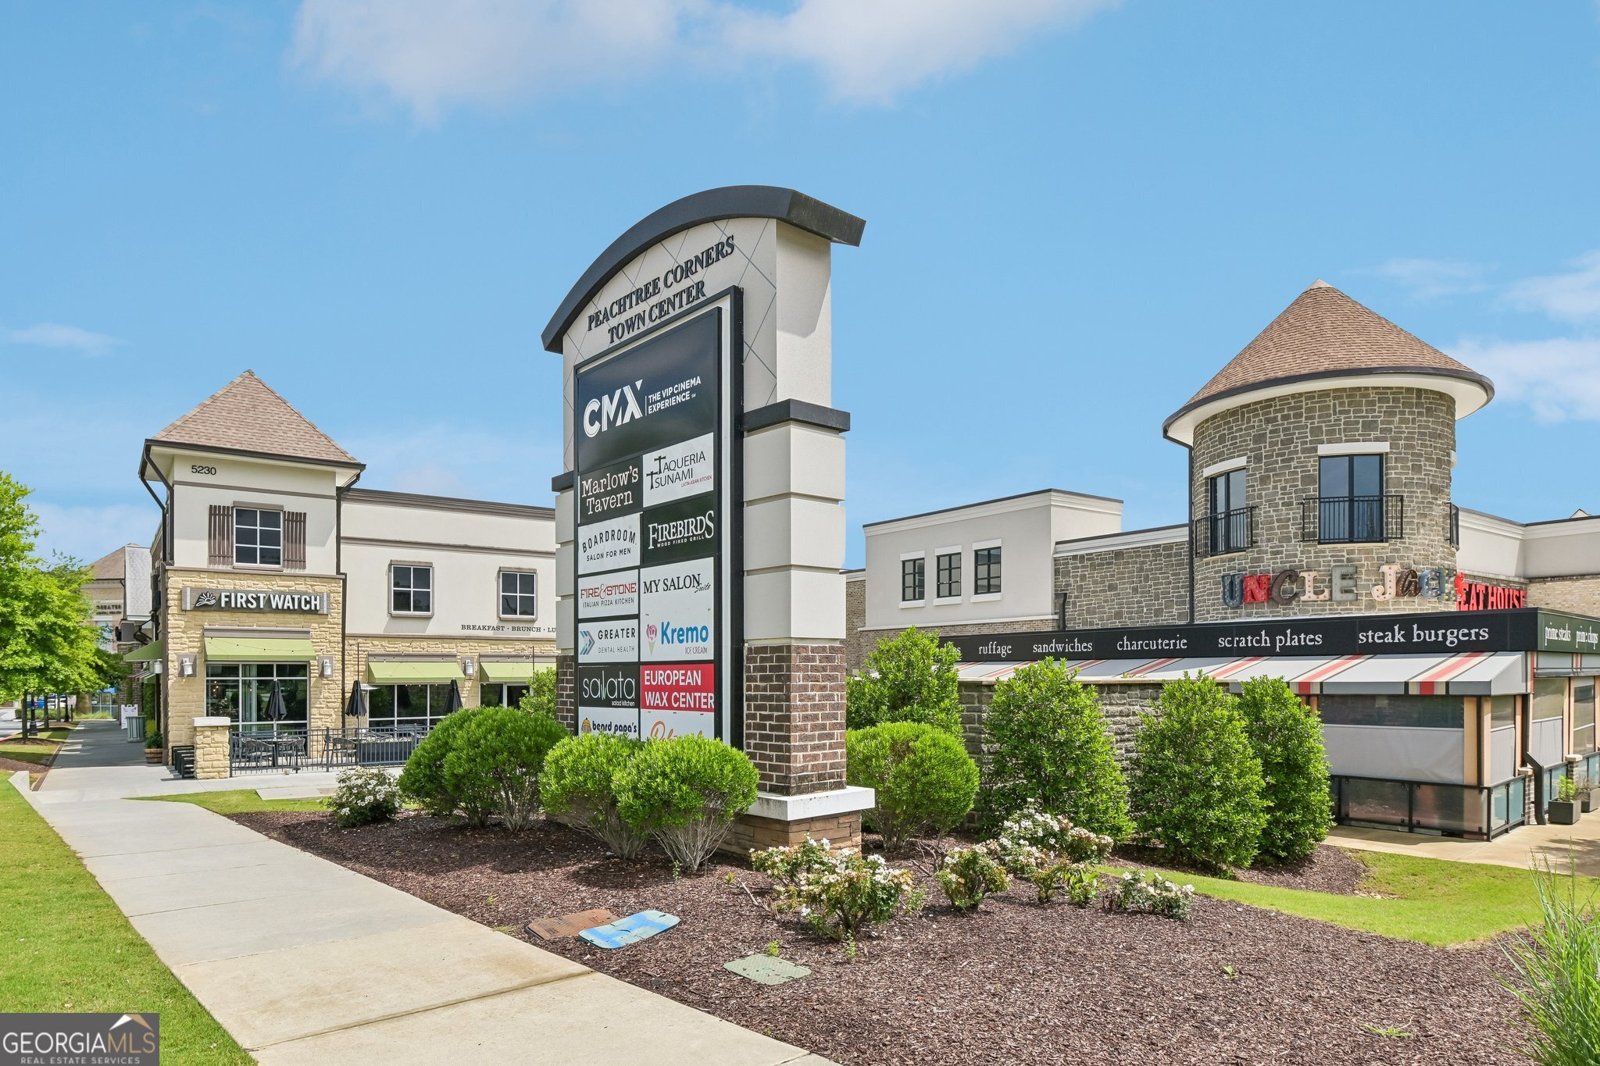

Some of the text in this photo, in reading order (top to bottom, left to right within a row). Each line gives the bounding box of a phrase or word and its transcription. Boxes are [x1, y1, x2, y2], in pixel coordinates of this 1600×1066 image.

[587, 235, 735, 331] PEACHTREE CORNERS
[608, 280, 706, 344] TOWN CENTER
[648, 376, 701, 404] THE VIP CINEMA
[583, 379, 643, 438] CMX
[648, 391, 690, 414] EXPERIENCE
[191, 465, 217, 476] 5230
[654, 450, 706, 475] TAQUERIA
[581, 465, 639, 497] Marlow's
[646, 468, 694, 490] TSUNAMI
[586, 490, 633, 515] Tavern
[582, 529, 636, 553] BOARDROOM
[648, 510, 714, 549] FIREBIRDS
[586, 548, 631, 562] SALON FOR MEN
[643, 579, 661, 594] MY
[663, 573, 701, 592] SALON
[1221, 565, 1358, 608] UNCLE
[220, 592, 320, 611] FIRST WATCH
[583, 597, 634, 608] ITALIAN PIZZA KITCHEN
[1457, 583, 1486, 611] EAT
[461, 624, 505, 632] BREAKFAST
[598, 628, 636, 640] GREATER
[661, 621, 709, 645] Kremo
[598, 645, 635, 654] DENTAL HEALTH
[693, 646, 708, 655] CREAM
[978, 641, 1012, 658] ruffage
[1032, 638, 1093, 653] sandwiches
[1117, 634, 1188, 651] charcuterie
[1218, 630, 1271, 647] scratch
[1276, 628, 1323, 652] plates
[1358, 623, 1406, 644] steak
[1412, 624, 1489, 647] burgers
[582, 670, 636, 701] salata
[644, 670, 701, 686] EUROPEAN
[645, 691, 714, 709] WAX CENTER
